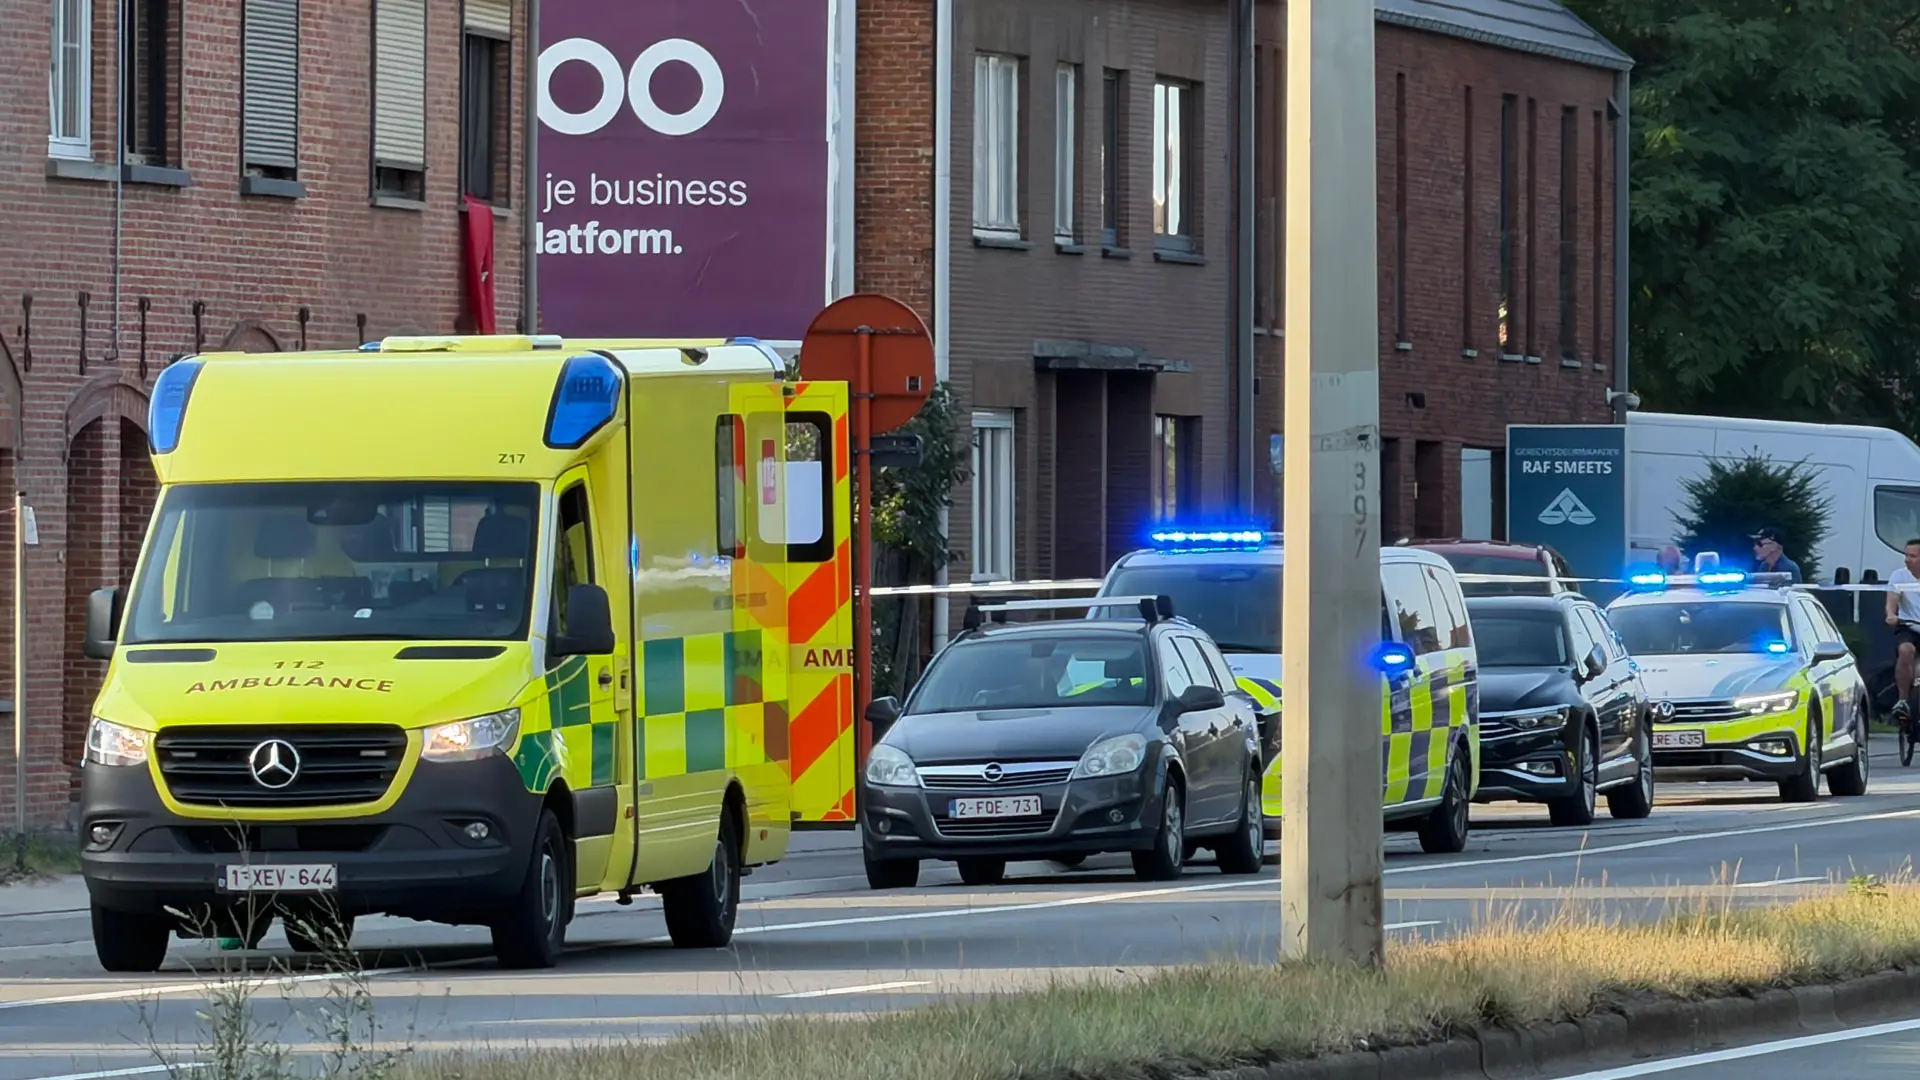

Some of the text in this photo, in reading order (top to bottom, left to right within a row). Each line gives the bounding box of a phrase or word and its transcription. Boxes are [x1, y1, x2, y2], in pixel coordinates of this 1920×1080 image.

[543, 173, 748, 212] je business
[498, 453, 526, 464] Z17
[1522, 461, 1612, 474] RAF SMEETS
[274, 660, 325, 670] 112
[184, 675, 395, 695] AMBULANCE
